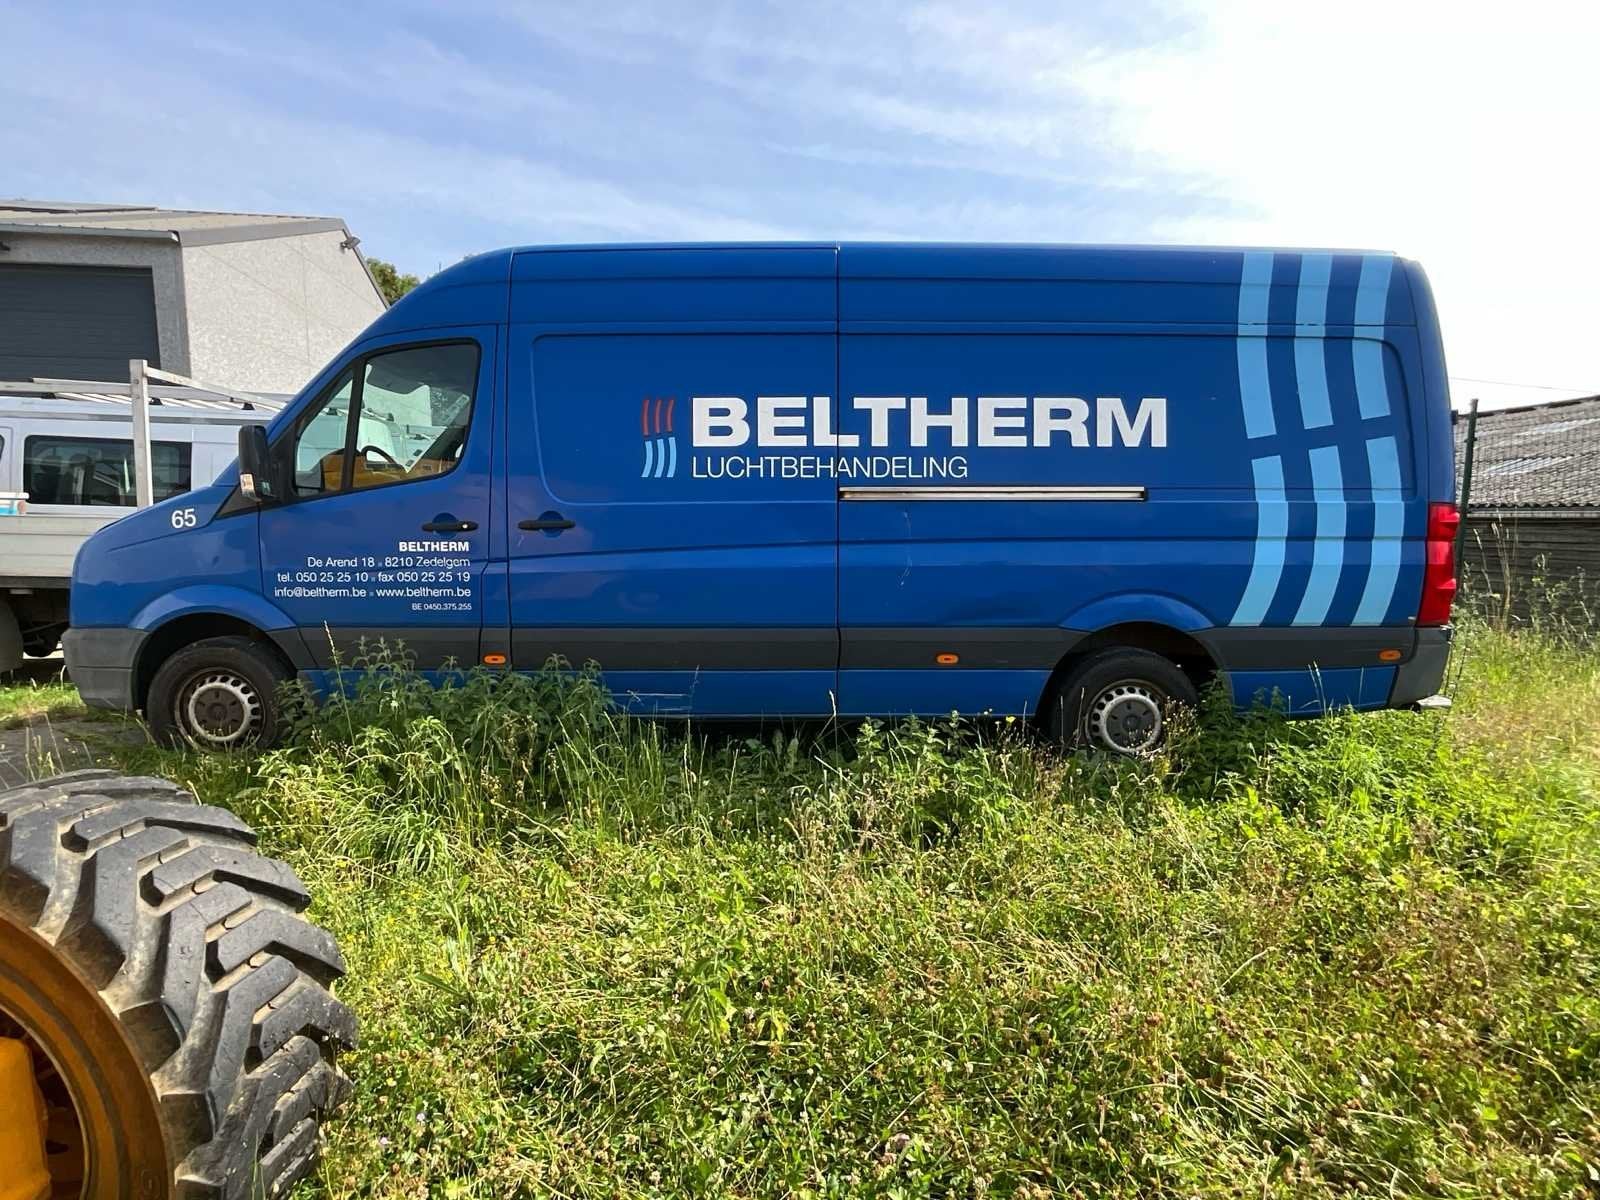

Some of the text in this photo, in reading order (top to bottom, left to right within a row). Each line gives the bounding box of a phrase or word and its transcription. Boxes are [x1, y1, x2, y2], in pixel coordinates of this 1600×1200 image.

[692, 396, 1167, 448] BELTHERM
[692, 455, 968, 479] LUCHTBEHANDELING
[171, 508, 197, 529] 65
[399, 541, 470, 552] BELTHERM
[307, 556, 471, 569] De Arend 18 8210 Zedelgem
[277, 571, 471, 583] tel. 050 25 25 10 fax 050 25 25 19
[274, 586, 472, 598] info@beltherm.be www.beltherm.be
[411, 602, 423, 611] BE
